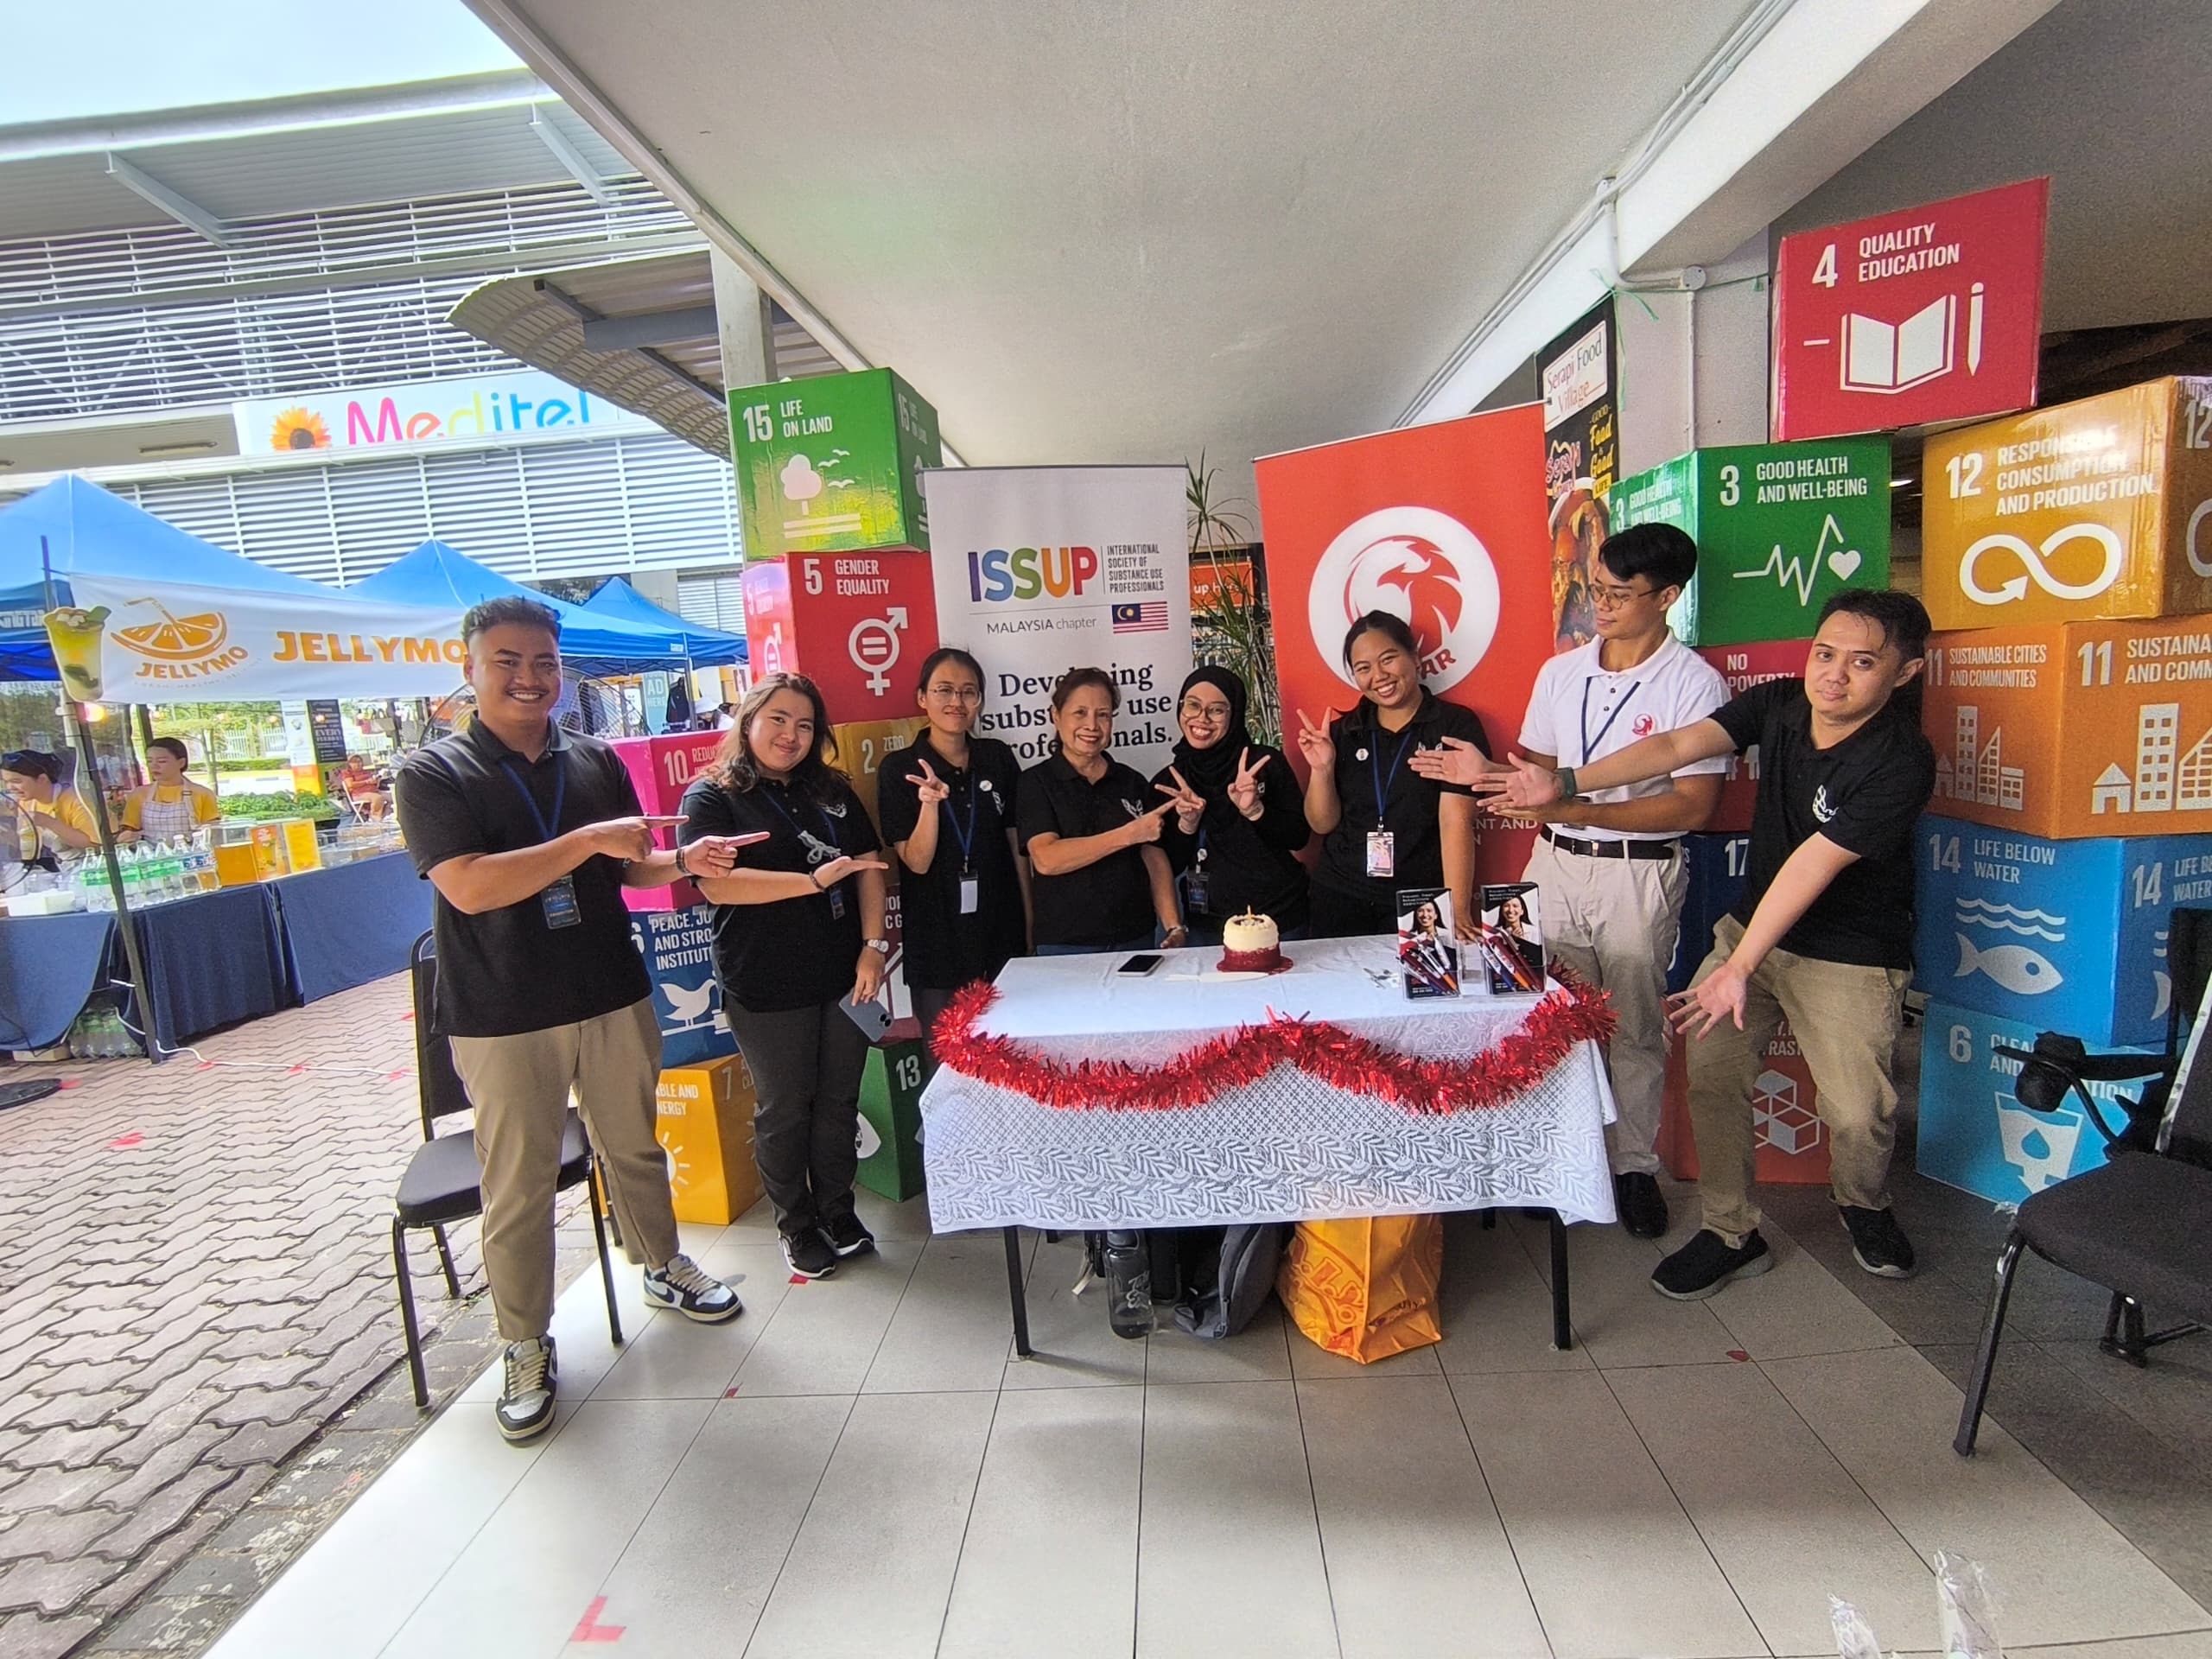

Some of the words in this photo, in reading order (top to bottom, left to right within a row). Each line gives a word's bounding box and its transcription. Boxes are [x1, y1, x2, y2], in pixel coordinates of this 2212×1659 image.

[1858, 222, 1936, 258] QUALITY
[1811, 244, 1839, 289] 4
[1858, 243, 1961, 283] EDUCATION
[1547, 353, 1575, 395] Serapi
[1576, 331, 1602, 372] Food
[779, 398, 804, 418] LIFE
[1558, 381, 1591, 413] Village
[347, 388, 590, 445] Meditel
[742, 403, 774, 443] 15
[782, 419, 799, 438] ON
[802, 415, 833, 435] LAND
[1756, 461, 1795, 481] GOOD
[1796, 455, 1849, 478] HEALTH
[1945, 452, 1984, 499] 12
[1996, 451, 2128, 492] CONSUMPTION
[1719, 464, 1740, 507] 3
[1757, 484, 1786, 505] AND
[1788, 477, 1868, 502] WELL-BEING
[1996, 493, 2031, 517] AND
[2032, 472, 2154, 512] PRODUCTION
[1616, 497, 1625, 533] 3
[1107, 543, 1160, 556] INTERNATIONAL
[1108, 556, 1137, 569] SOCIETY
[1139, 556, 1147, 567] OF
[803, 558, 824, 595] 5
[834, 558, 880, 576] GENDER
[967, 546, 1098, 602] ISSUP
[1109, 569, 1149, 582] SUBSTANCE
[1149, 568, 1163, 580] USE
[836, 578, 890, 596] EQUALITY
[1109, 581, 1165, 594] PROFESSIONALS
[987, 619, 1054, 635] MALAYSIA
[1055, 617, 1097, 631] chapter
[135, 645, 249, 679] JELLYMO
[272, 631, 468, 664] JELLYMO
[1726, 652, 1748, 671] NO
[1948, 645, 2012, 665] SUSTAINABLE
[2013, 644, 2047, 664] CITIES
[2077, 639, 2113, 687] 11
[1924, 647, 1943, 687] 11
[1948, 669, 1969, 687] AND
[1969, 669, 2037, 689] COMMUNITIES
[2124, 662, 2161, 685] AND
[1127, 696, 1172, 716] use
[861, 738, 876, 774] 2
[882, 734, 906, 753] ZERO
[664, 748, 689, 787] 10
[1499, 817, 1538, 830] AND
[1724, 838, 1750, 877] 17
[1928, 833, 1961, 874] 14
[1974, 838, 2001, 859] LIFE
[2004, 842, 2056, 866] BELOW
[2174, 856, 2199, 878] LIFE
[1974, 861, 2020, 885] WATER
[2132, 861, 2164, 909] 14
[2173, 880, 2212, 902] WATER
[654, 933, 680, 952] AND
[1949, 1023, 1973, 1064] 6
[895, 1054, 922, 1091] 13
[1989, 1055, 2024, 1077] AND
[678, 1083, 699, 1099] AND
[721, 1065, 734, 1100] 7
